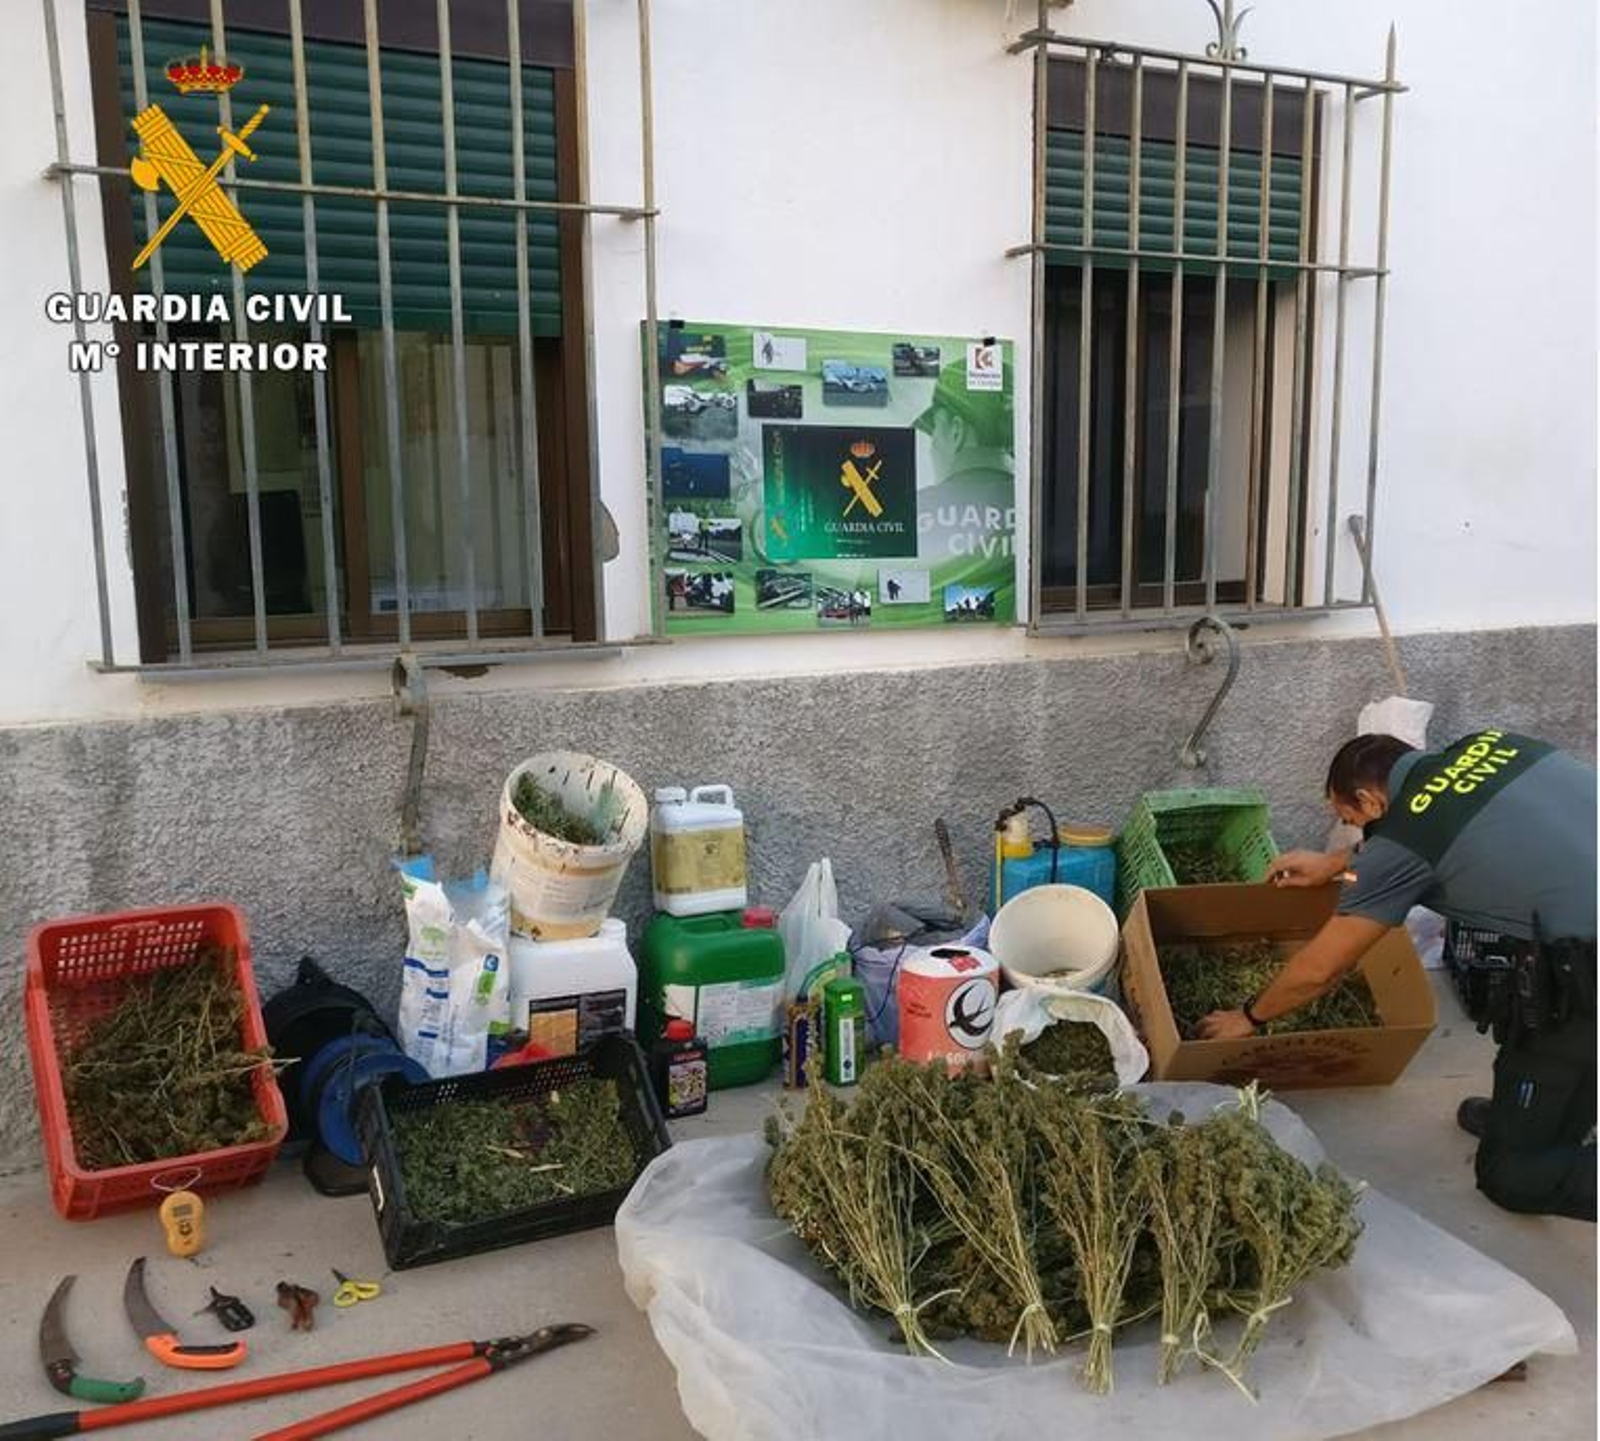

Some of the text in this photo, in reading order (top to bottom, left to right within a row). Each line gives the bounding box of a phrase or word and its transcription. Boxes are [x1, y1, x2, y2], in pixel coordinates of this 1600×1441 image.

[824, 521, 905, 535] GUARDIA CIVIL
[1453, 748, 1519, 794] CIVIL
